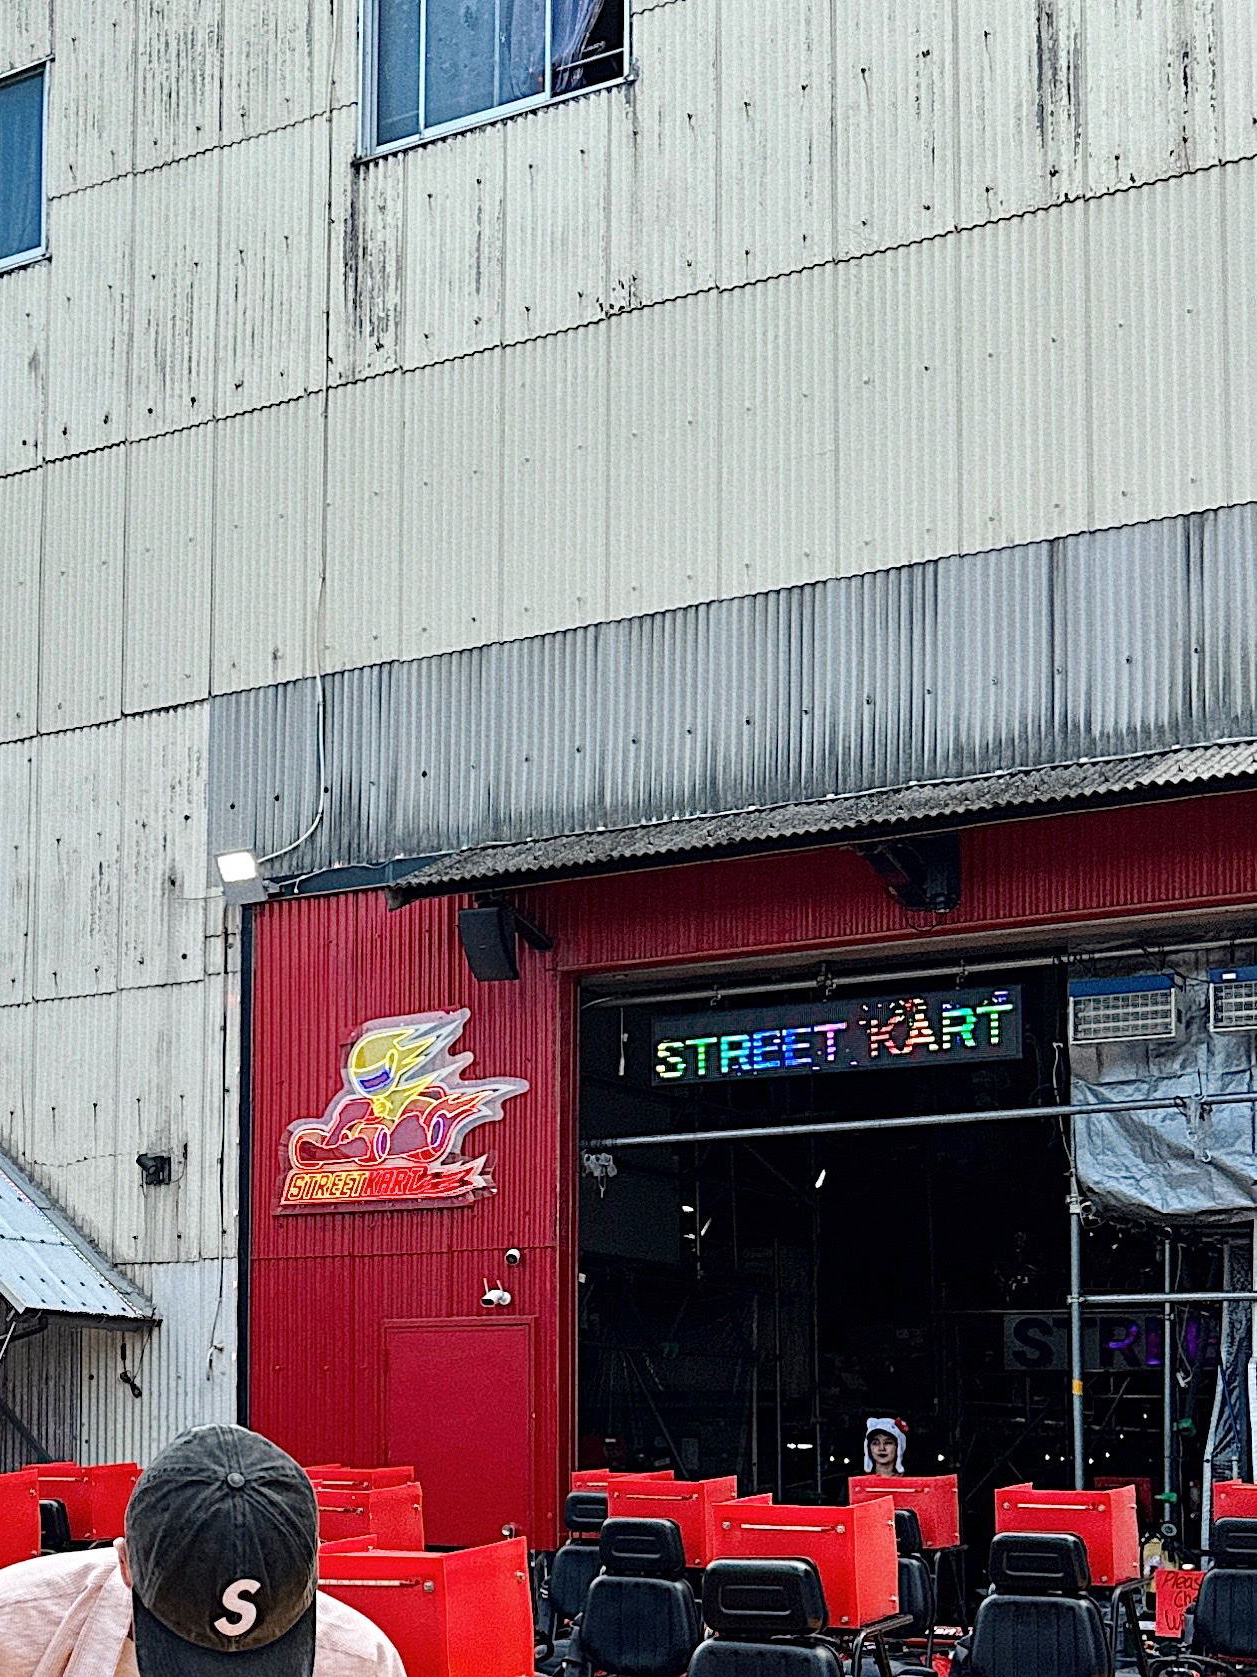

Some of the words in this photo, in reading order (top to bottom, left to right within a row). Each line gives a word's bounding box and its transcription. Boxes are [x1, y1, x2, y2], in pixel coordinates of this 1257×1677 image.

[656, 1021, 846, 1078] STREET
[861, 997, 1013, 1058] KART
[213, 1578, 261, 1637] S
[1162, 1571, 1199, 1591] Pleas
